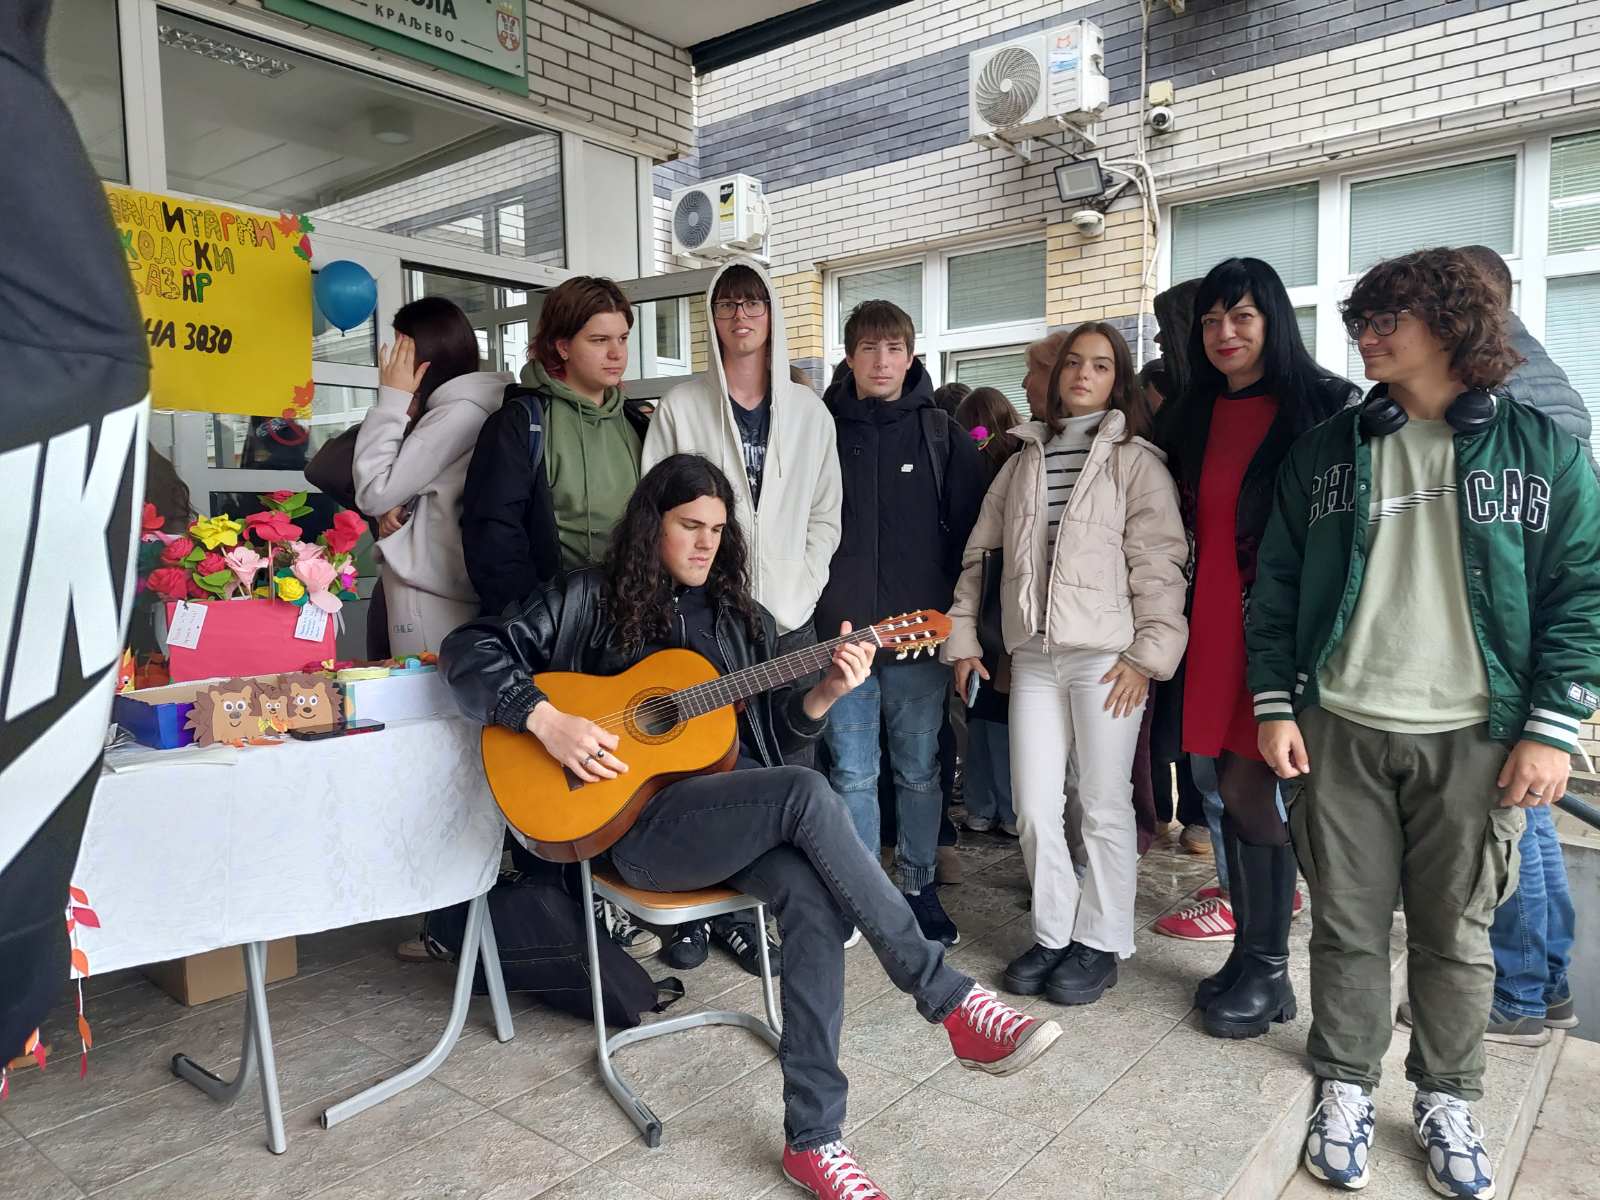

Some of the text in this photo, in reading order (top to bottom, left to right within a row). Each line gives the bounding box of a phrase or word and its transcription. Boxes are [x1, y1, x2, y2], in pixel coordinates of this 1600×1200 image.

[375, 4, 455, 42] КРАЉЕВО
[144, 317, 233, 354] НА 3030
[1464, 468, 1550, 533] CAG
